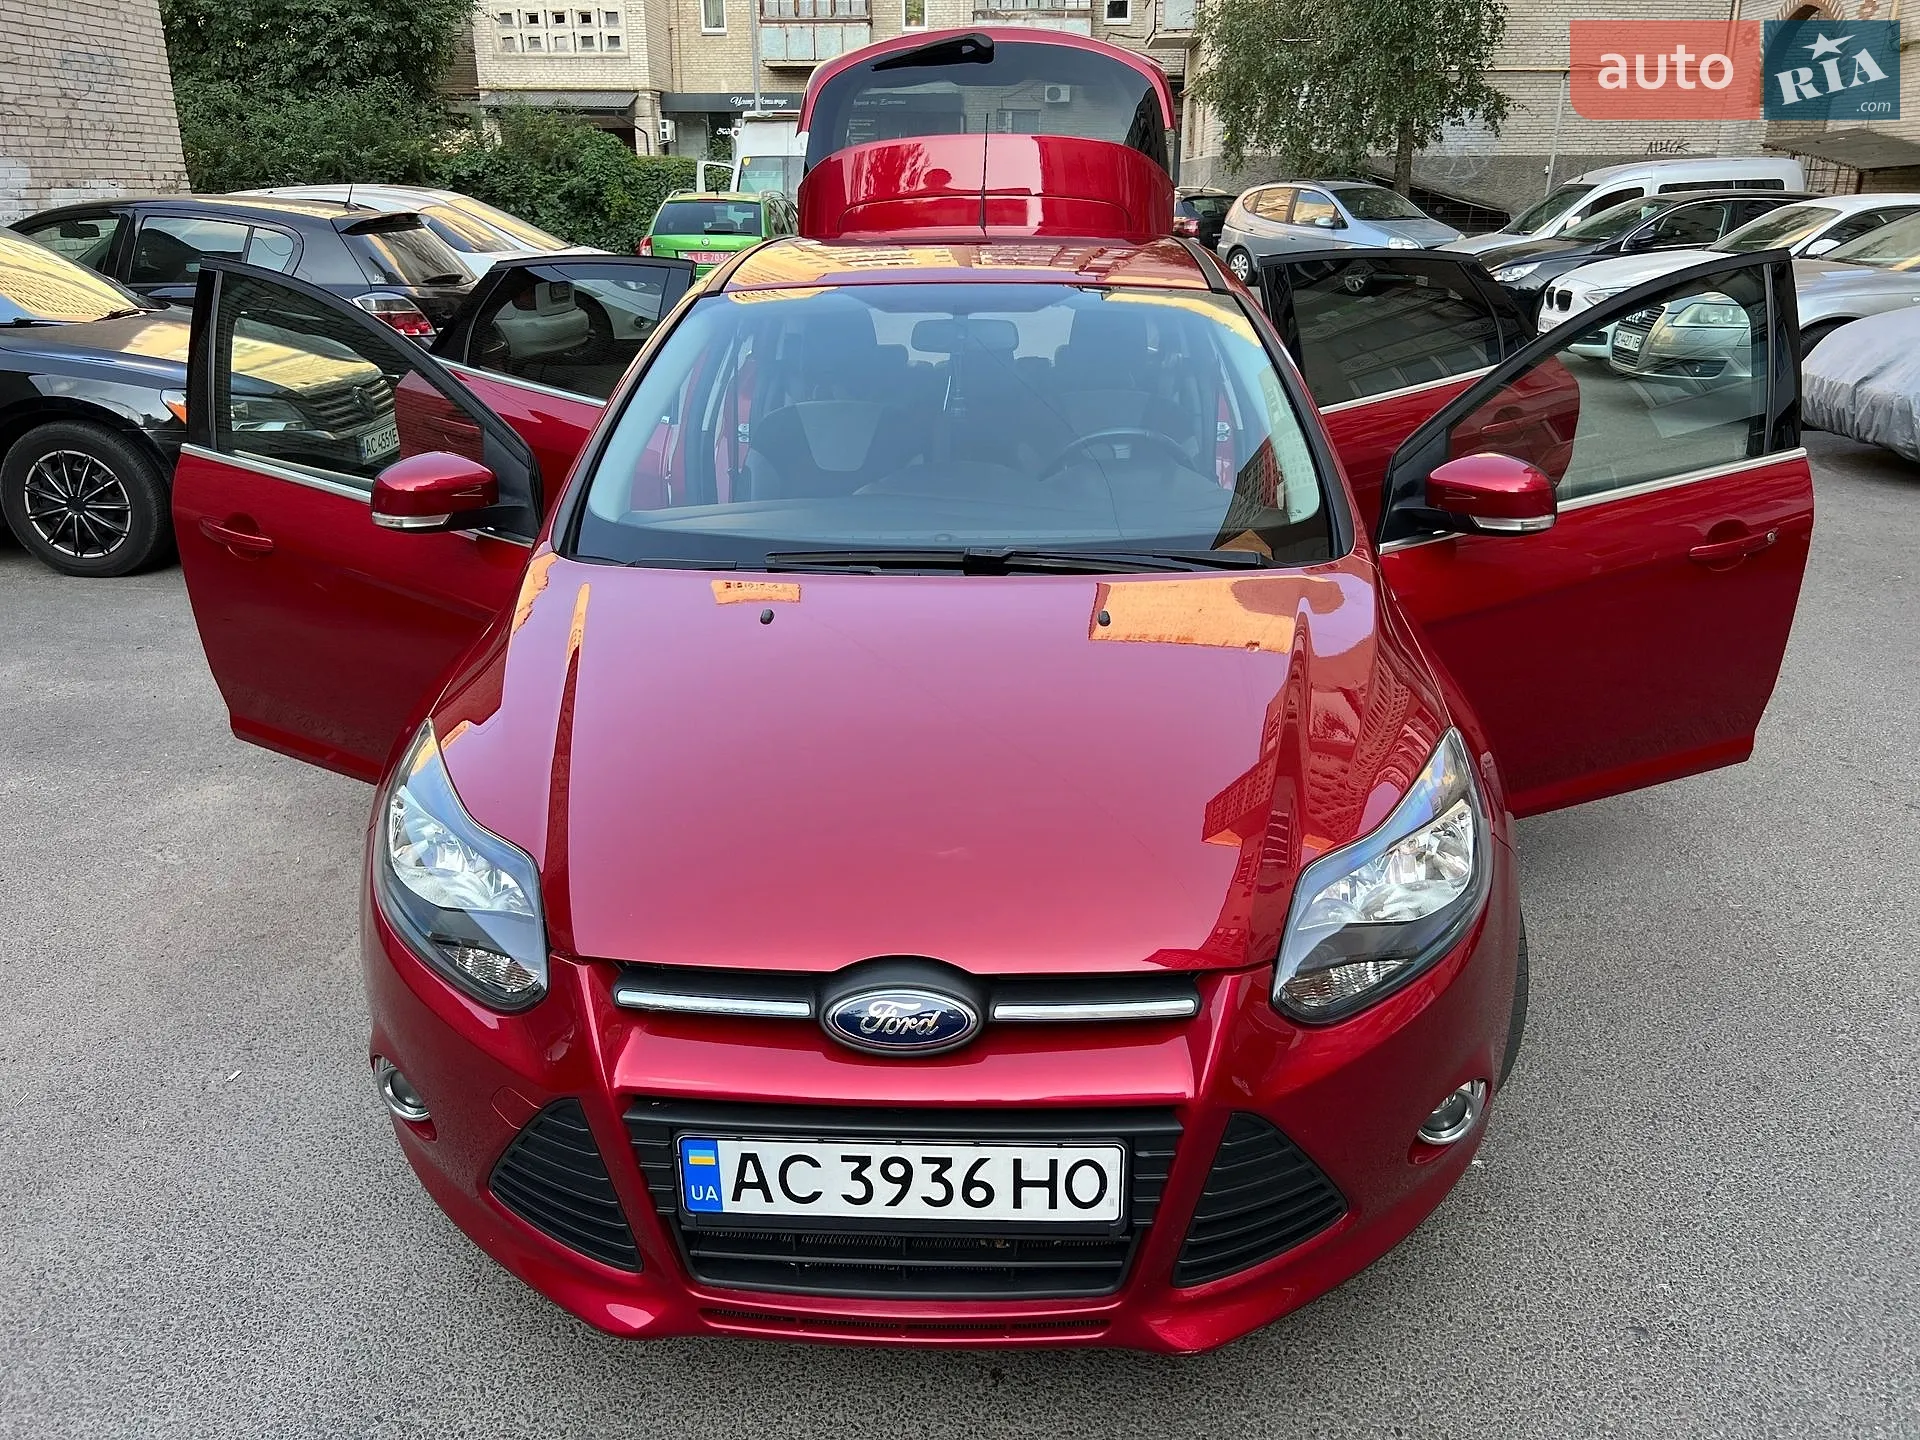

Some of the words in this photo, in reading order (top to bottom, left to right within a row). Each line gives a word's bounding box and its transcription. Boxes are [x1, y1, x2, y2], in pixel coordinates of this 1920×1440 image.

[365, 437, 378, 456] AC
[860, 1000, 941, 1036] Ford
[691, 1185, 719, 1201] UA
[731, 1152, 823, 1205] AC
[840, 1154, 995, 1208] 3936
[1012, 1158, 1109, 1211] HO
